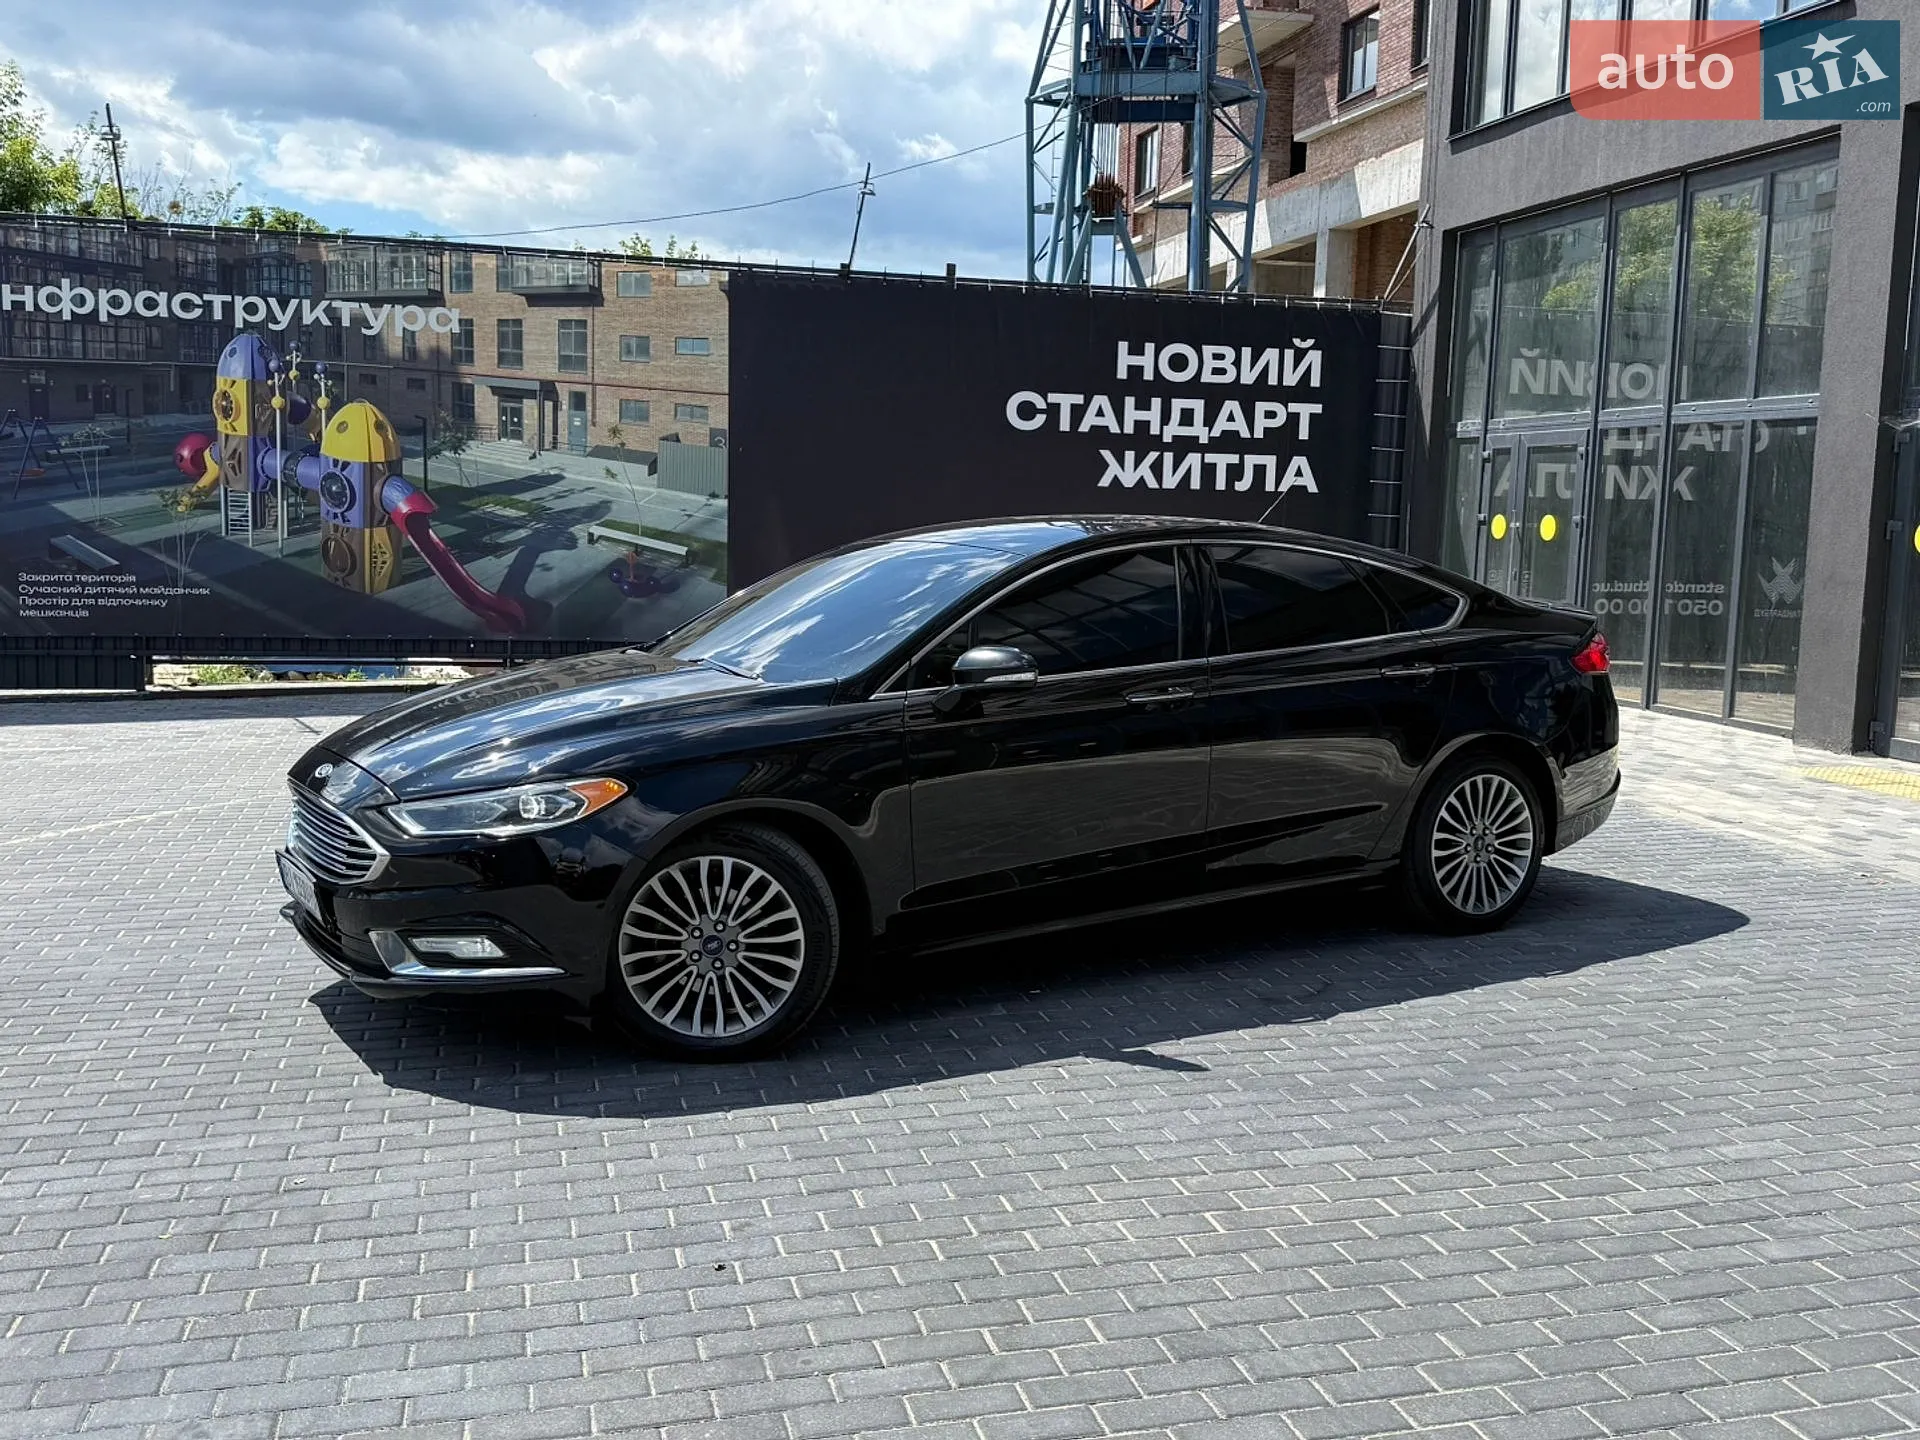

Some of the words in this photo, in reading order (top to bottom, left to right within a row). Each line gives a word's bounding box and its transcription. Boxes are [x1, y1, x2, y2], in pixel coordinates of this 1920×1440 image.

[1, 278, 461, 336] нфраструктура
[1115, 337, 1323, 388] НОВИЙ
[1005, 390, 1323, 444] СТАНДАРТ
[1096, 449, 1320, 493] ЖИТЛА
[18, 572, 73, 583] Закрита
[74, 573, 136, 583] територія
[18, 584, 82, 595] Сучасний
[83, 584, 138, 595] дитячий
[139, 585, 211, 596] майданчик
[19, 596, 70, 607] Простір
[71, 597, 96, 607] для
[98, 596, 168, 608] відпочинку
[19, 607, 90, 618] мешканців
